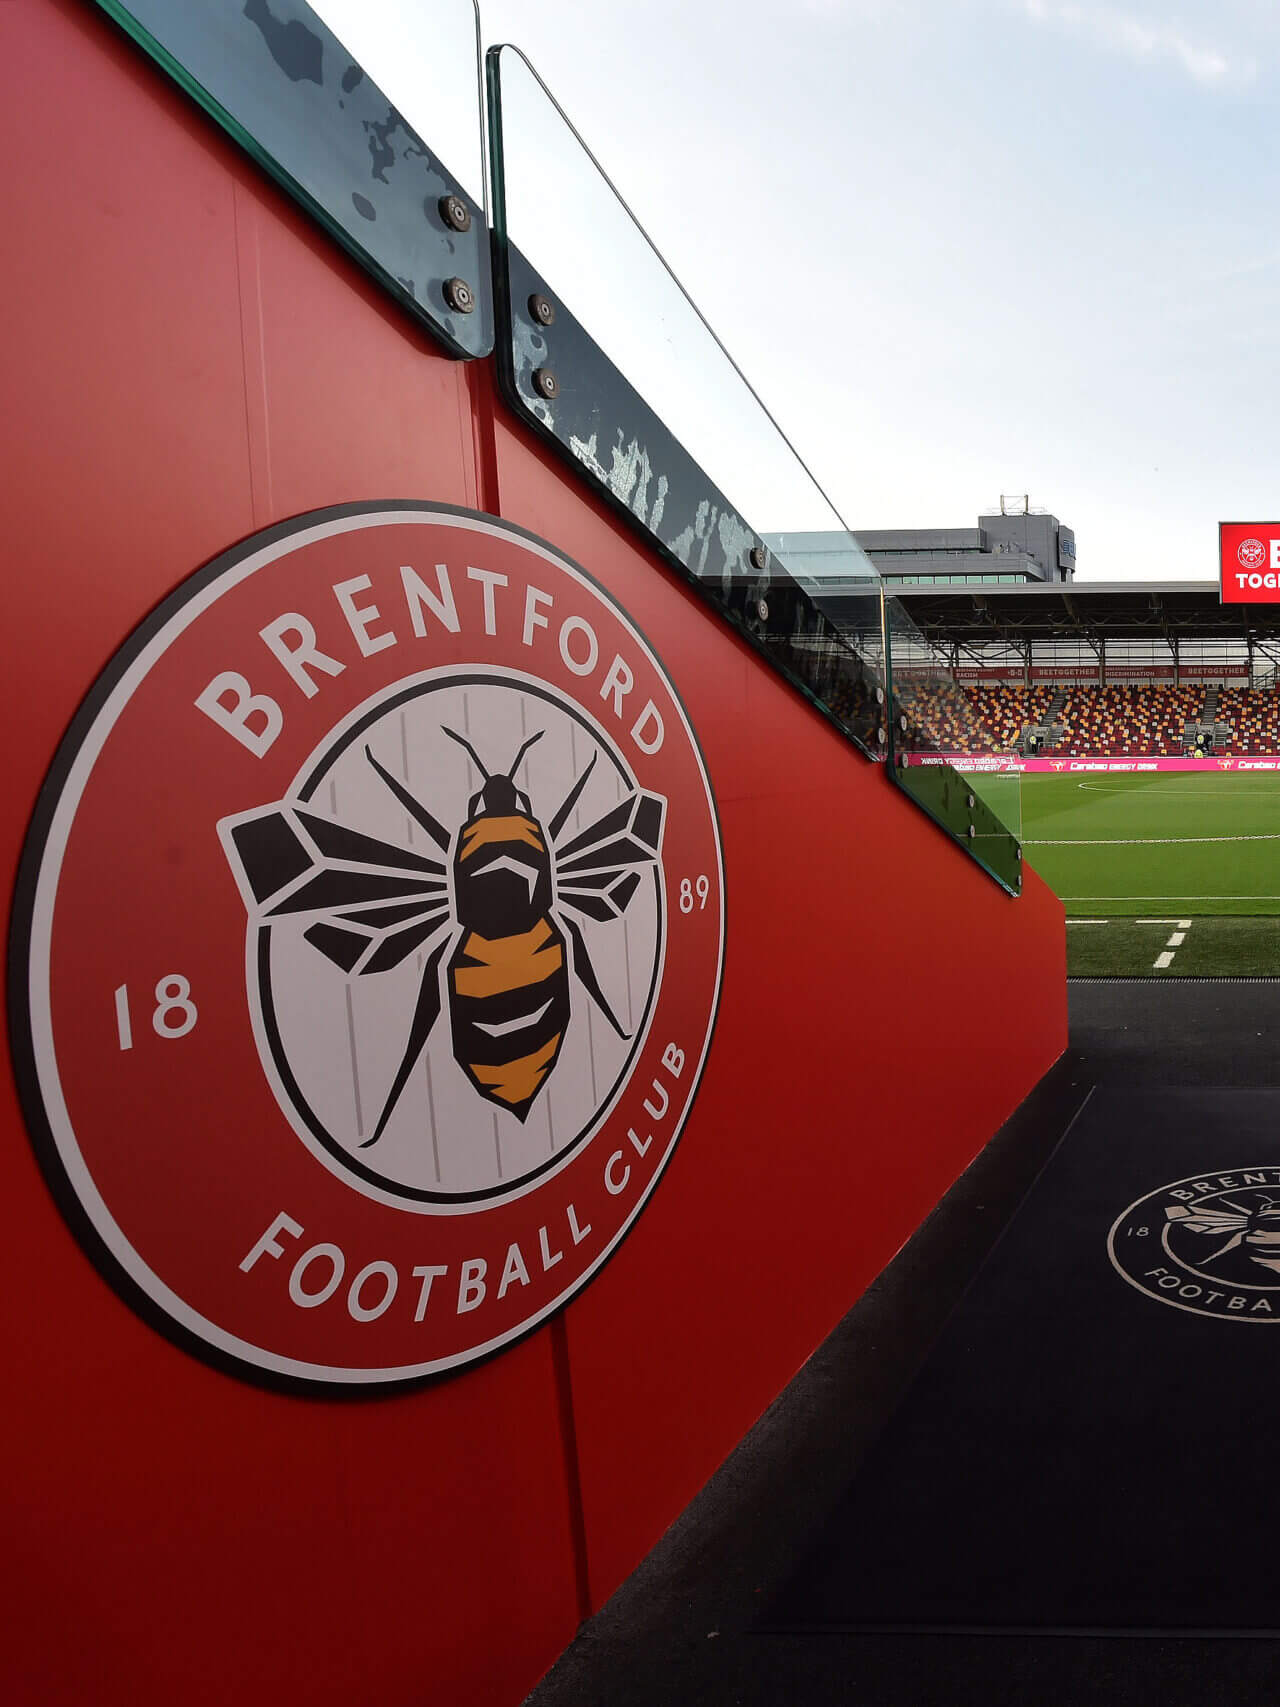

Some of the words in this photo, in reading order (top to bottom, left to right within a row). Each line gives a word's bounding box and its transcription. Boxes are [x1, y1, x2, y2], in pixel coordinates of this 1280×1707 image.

[194, 564, 665, 759] BRENTFORD
[1238, 761, 1276, 769] Carabao
[679, 875, 709, 914] 89
[114, 974, 198, 1050] 18
[239, 1211, 592, 1323] FOOTBALL
[604, 1042, 686, 1195] CLUB
[1126, 1226, 1150, 1237] 18
